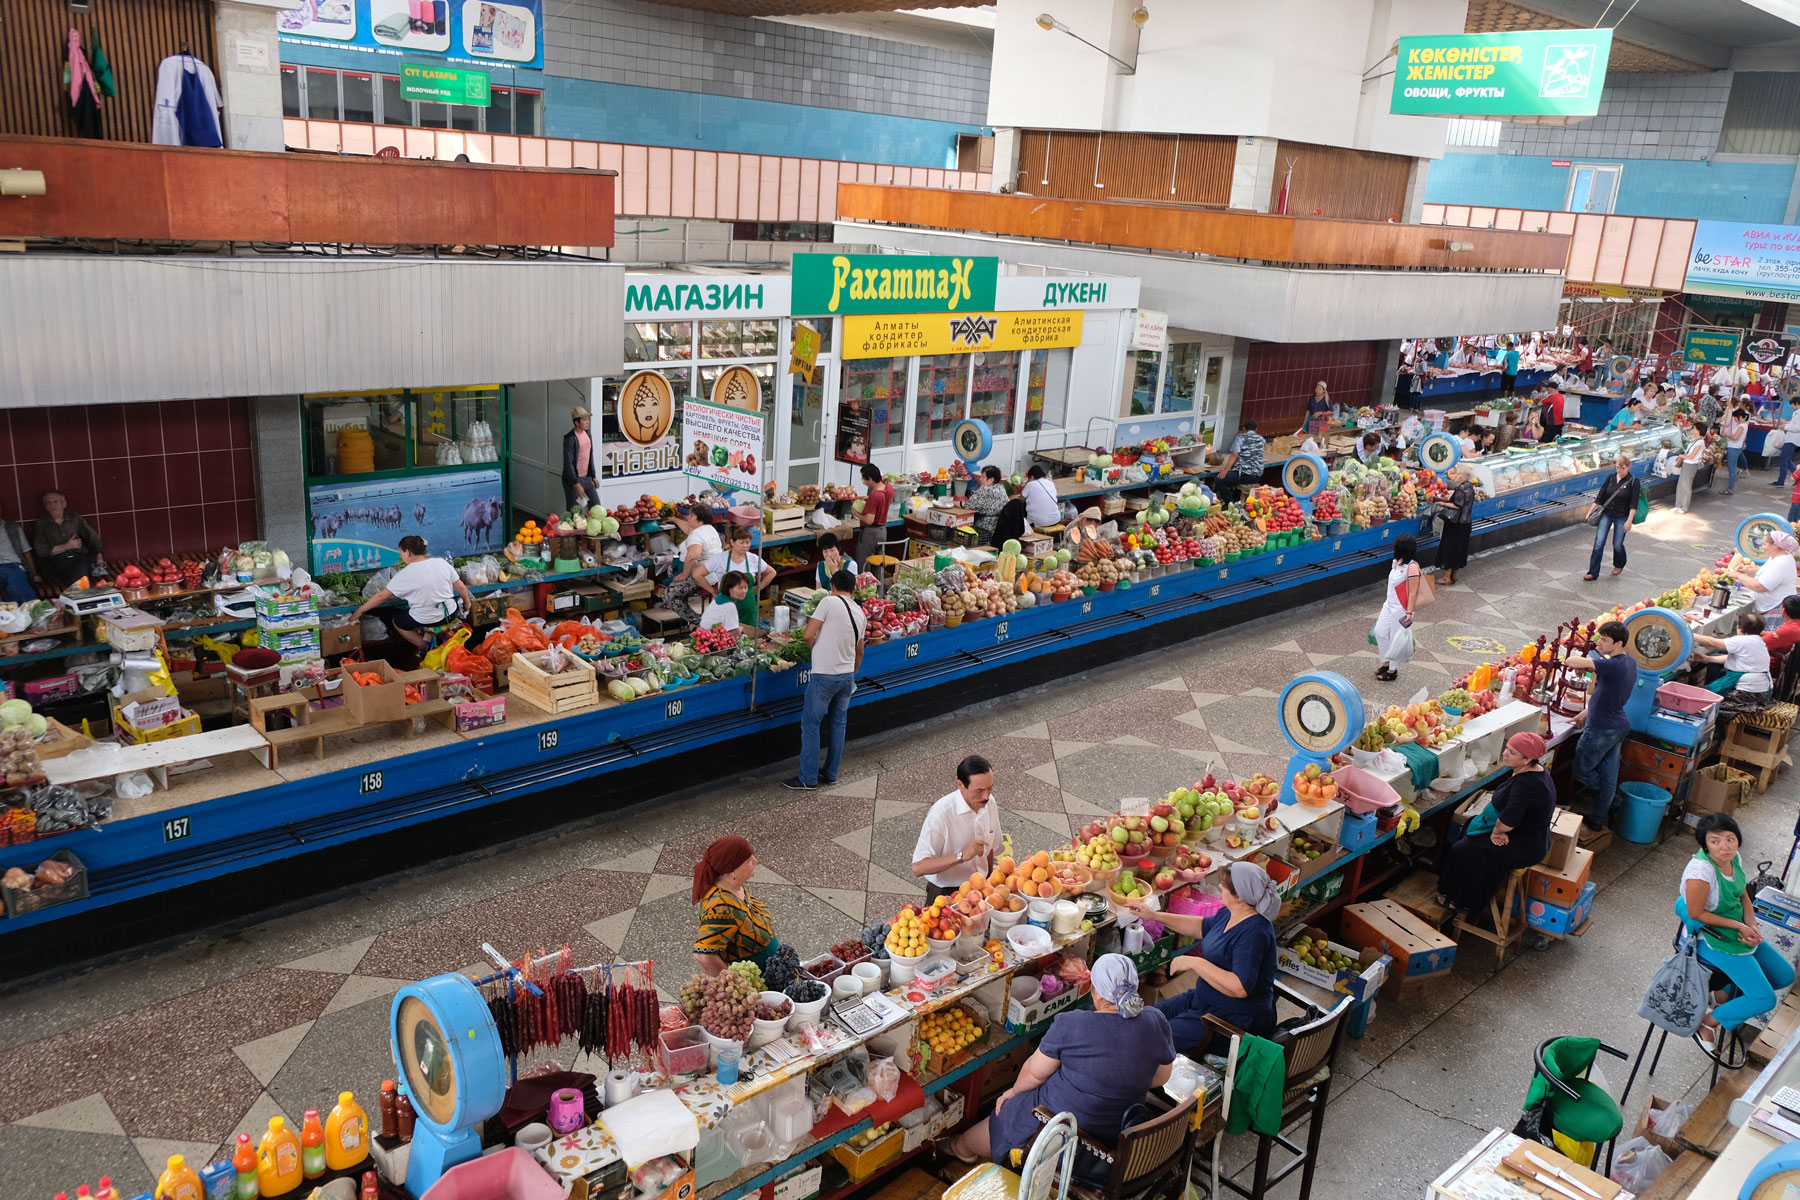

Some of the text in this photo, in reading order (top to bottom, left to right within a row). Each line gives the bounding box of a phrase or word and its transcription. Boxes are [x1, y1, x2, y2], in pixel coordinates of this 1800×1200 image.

[1408, 46, 1523, 64] КӨКӨНІСТЕР,
[1406, 64, 1495, 80] ЖЕМІСТЕР
[1404, 86, 1505, 99] ОВОЩИ, ФРУКТЫ
[1742, 230, 1770, 240] АВИА
[1745, 241, 1767, 250] туры
[1770, 242, 1782, 250] по
[625, 284, 764, 312] МАГАЗИН
[1042, 282, 1107, 308] ДҮКЕНІ
[874, 322, 918, 330] Алматы
[1014, 317, 1071, 326] Алматинская
[870, 332, 923, 342] кондитер
[1012, 326, 1071, 336] кондитерская
[862, 340, 928, 352] фабрикасы
[1022, 334, 1058, 344] фабрика
[685, 402, 761, 426] ЭКОЛОГИЧЕСКИ ЧИСТЫЕ
[685, 418, 760, 442] ВЫСШЕГО КАЧЕСТВА
[741, 424, 760, 434] ОВОЩИ
[694, 430, 752, 450] НЕМЕЦКИЕ СОРТА
[1082, 602, 1092, 614] 164
[998, 621, 1008, 634] 163
[907, 643, 918, 658] 162
[668, 700, 682, 716] 160
[542, 730, 558, 748] 159
[363, 772, 382, 792] 158
[166, 818, 188, 839] 157
